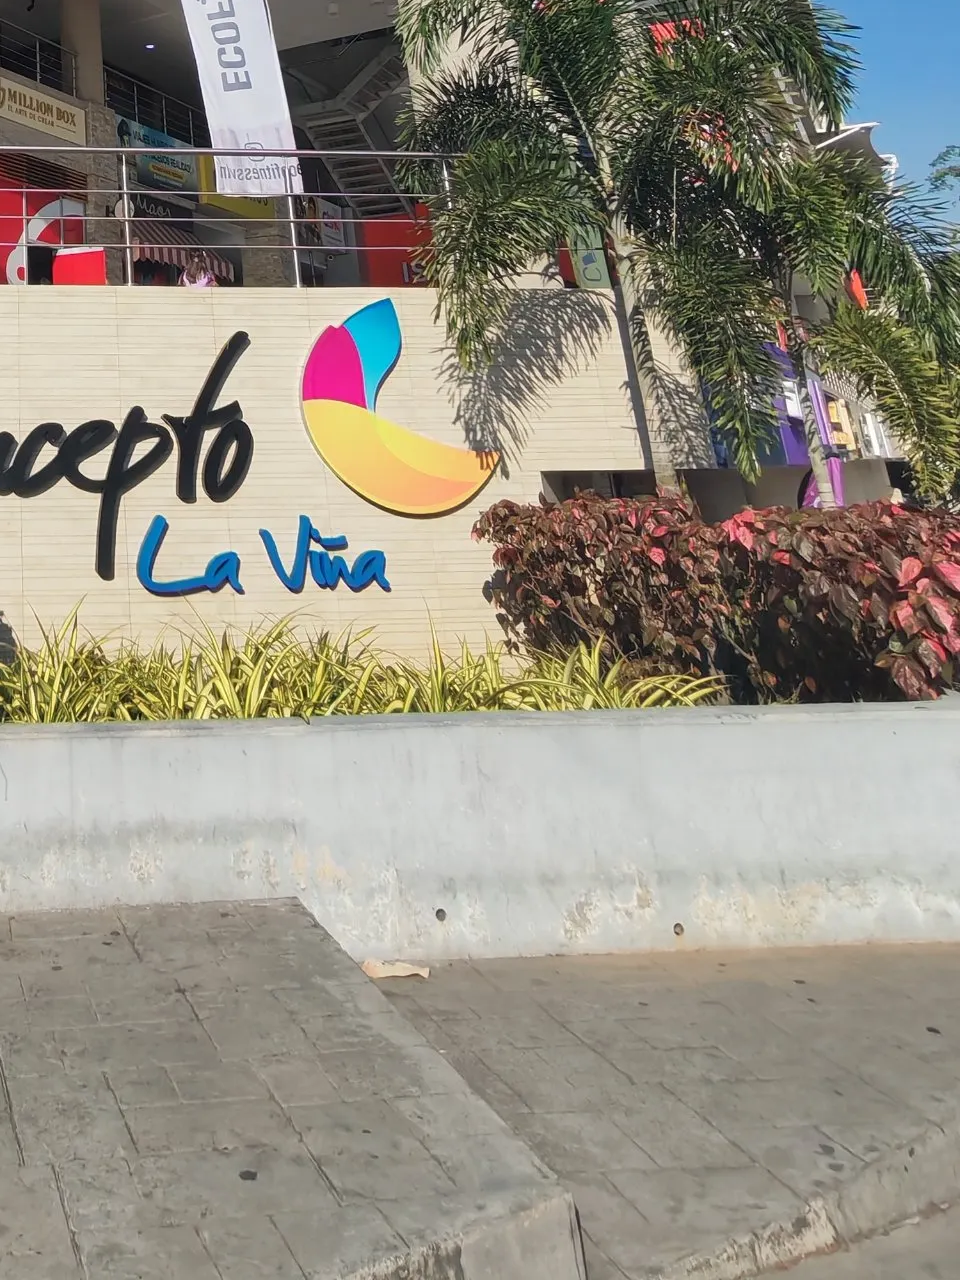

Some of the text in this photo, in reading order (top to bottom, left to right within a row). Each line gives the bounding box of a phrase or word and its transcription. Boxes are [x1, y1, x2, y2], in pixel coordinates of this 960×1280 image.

[8, 88, 77, 127] MILLION BOX
[136, 514, 391, 597] La Viña
